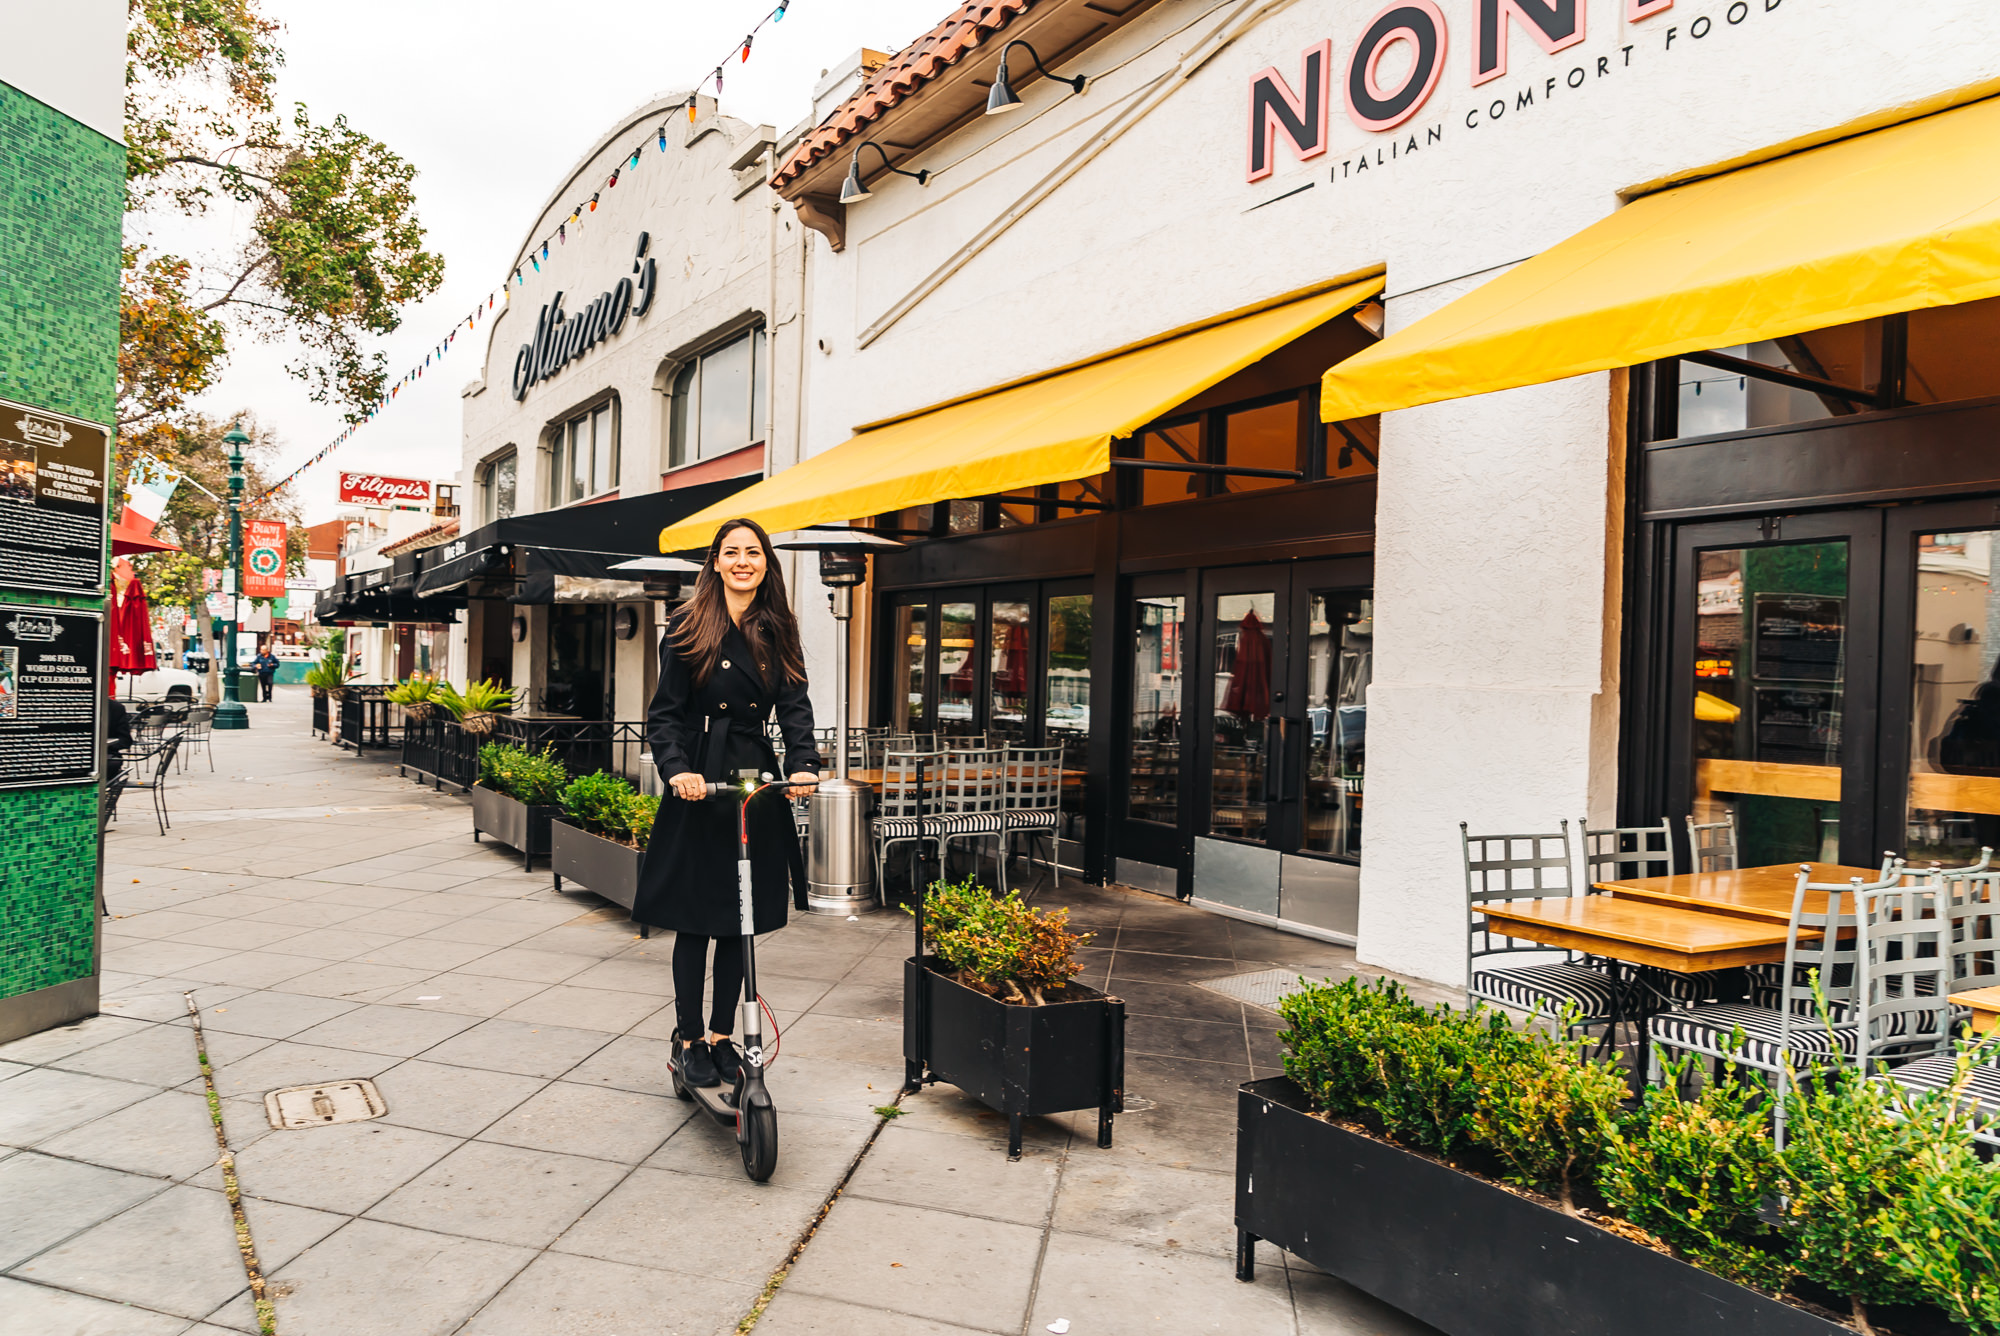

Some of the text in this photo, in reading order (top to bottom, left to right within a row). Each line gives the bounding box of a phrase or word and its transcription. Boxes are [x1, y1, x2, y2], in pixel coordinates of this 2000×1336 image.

[1247, 0, 1674, 184] NON
[1329, 123, 1443, 184] ITALIAN
[1466, 44, 1635, 129] COMFORT
[37, 468, 103, 489] WINTER OLYMPIC
[52, 480, 89, 494] OPENING
[41, 487, 96, 504] CELEBRATION
[351, 494, 379, 505] PIZZA
[252, 521, 281, 535] Buon
[248, 533, 284, 548] Natale
[57, 654, 76, 663] FIFA
[25, 664, 88, 674] WORLD SOCCER
[19, 675, 92, 684] CUP CELEBRATION
